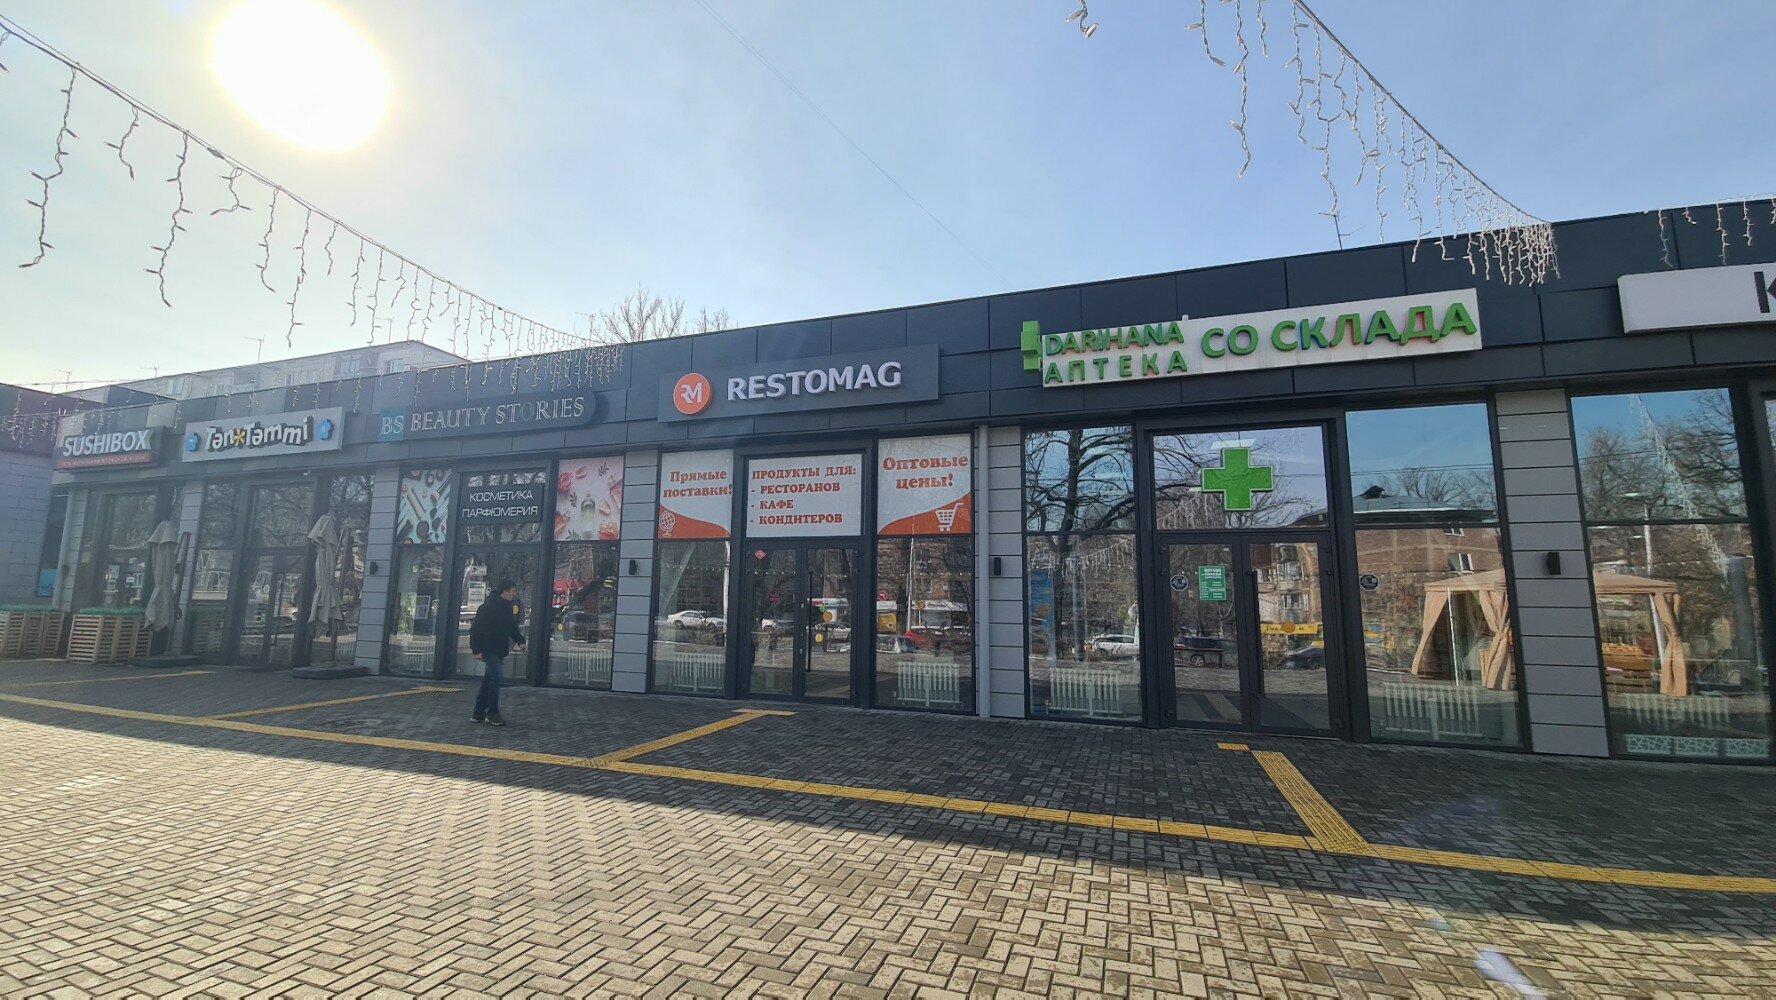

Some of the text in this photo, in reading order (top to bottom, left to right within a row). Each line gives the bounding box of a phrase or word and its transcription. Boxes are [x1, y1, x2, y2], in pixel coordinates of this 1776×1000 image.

[1201, 302, 1478, 359] СО СКЛАДА
[1045, 321, 1185, 357] DARIHANA
[1044, 350, 1188, 384] АПТЕКА
[727, 361, 902, 401] RESTOMAG
[410, 396, 584, 432] BEAUTY STORIES
[381, 415, 404, 435] BS
[62, 429, 152, 457] SUSHIBOX
[883, 456, 969, 471] Оптовые
[670, 471, 727, 484] Прямые
[752, 466, 857, 480] ПРОДУКТЫ ДЛЯ:
[760, 482, 841, 495] РЕСТОРАНОВ
[896, 473, 954, 490] цены!
[469, 490, 534, 502] КОСМЕТИКА
[663, 483, 733, 498] поставки!
[461, 506, 538, 518] ПАРФЮМЕРИЯ
[759, 499, 794, 510] КАФЕ
[759, 513, 843, 525] КОНДИТЕРОВ
